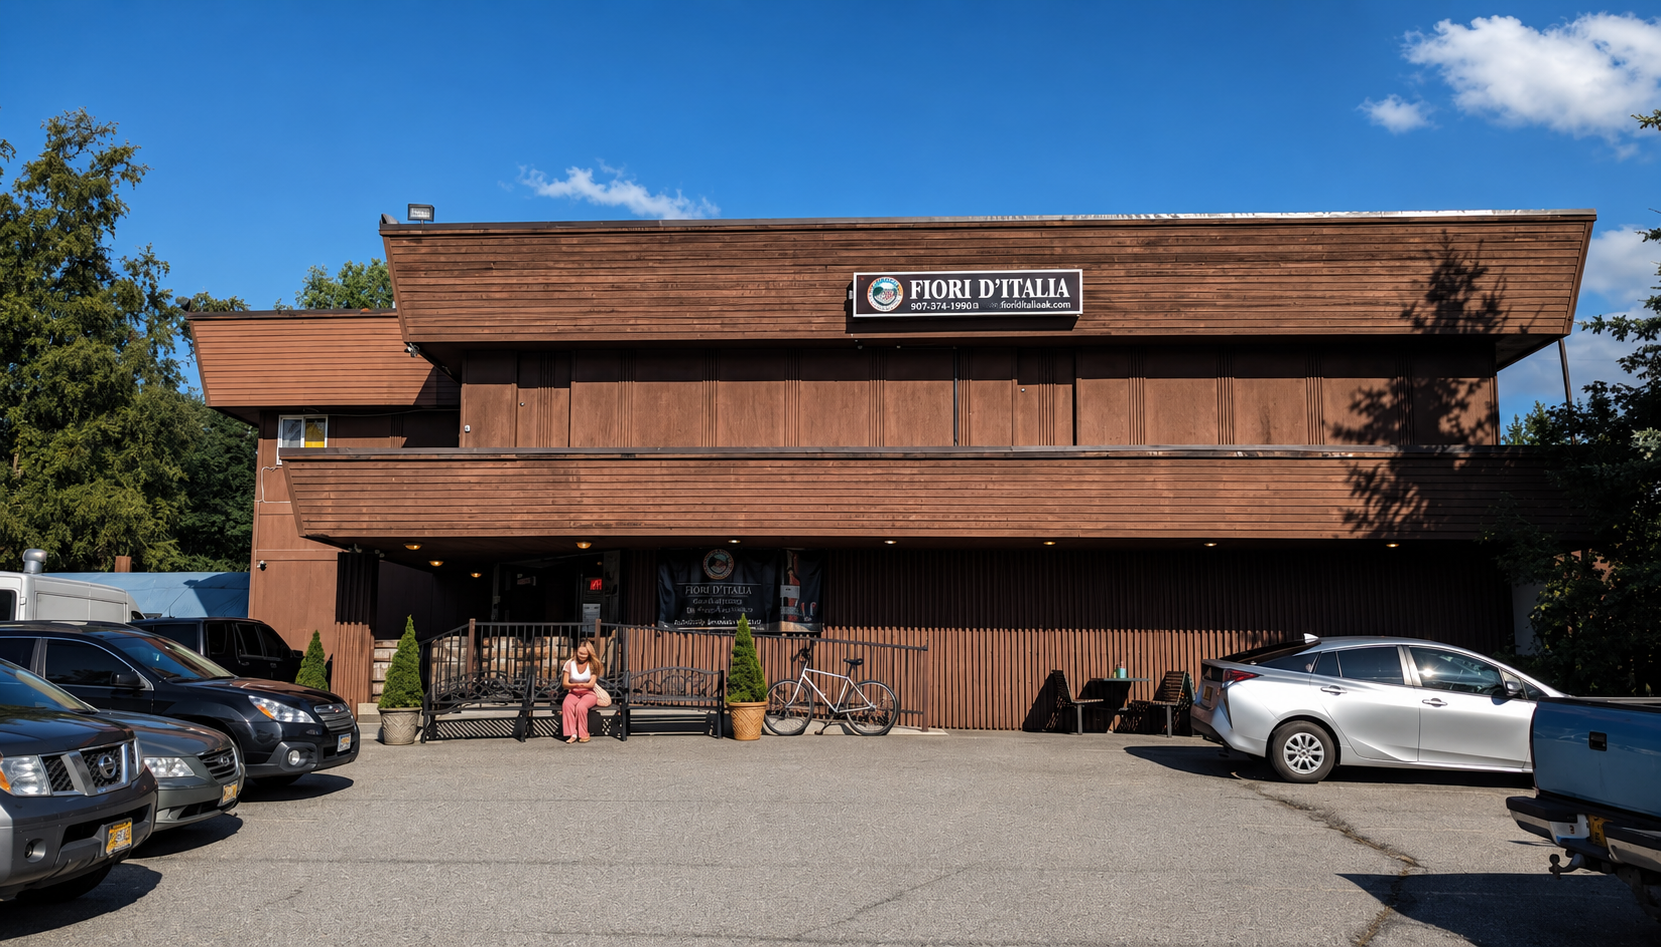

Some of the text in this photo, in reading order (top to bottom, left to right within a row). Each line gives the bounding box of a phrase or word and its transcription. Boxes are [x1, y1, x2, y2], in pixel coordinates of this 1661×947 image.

[909, 279, 972, 299] FIORI
[978, 277, 1071, 299] D'ITALIA
[910, 302, 972, 311] 907-374-1990
[685, 585, 752, 595] FIORI D'ITALIA
